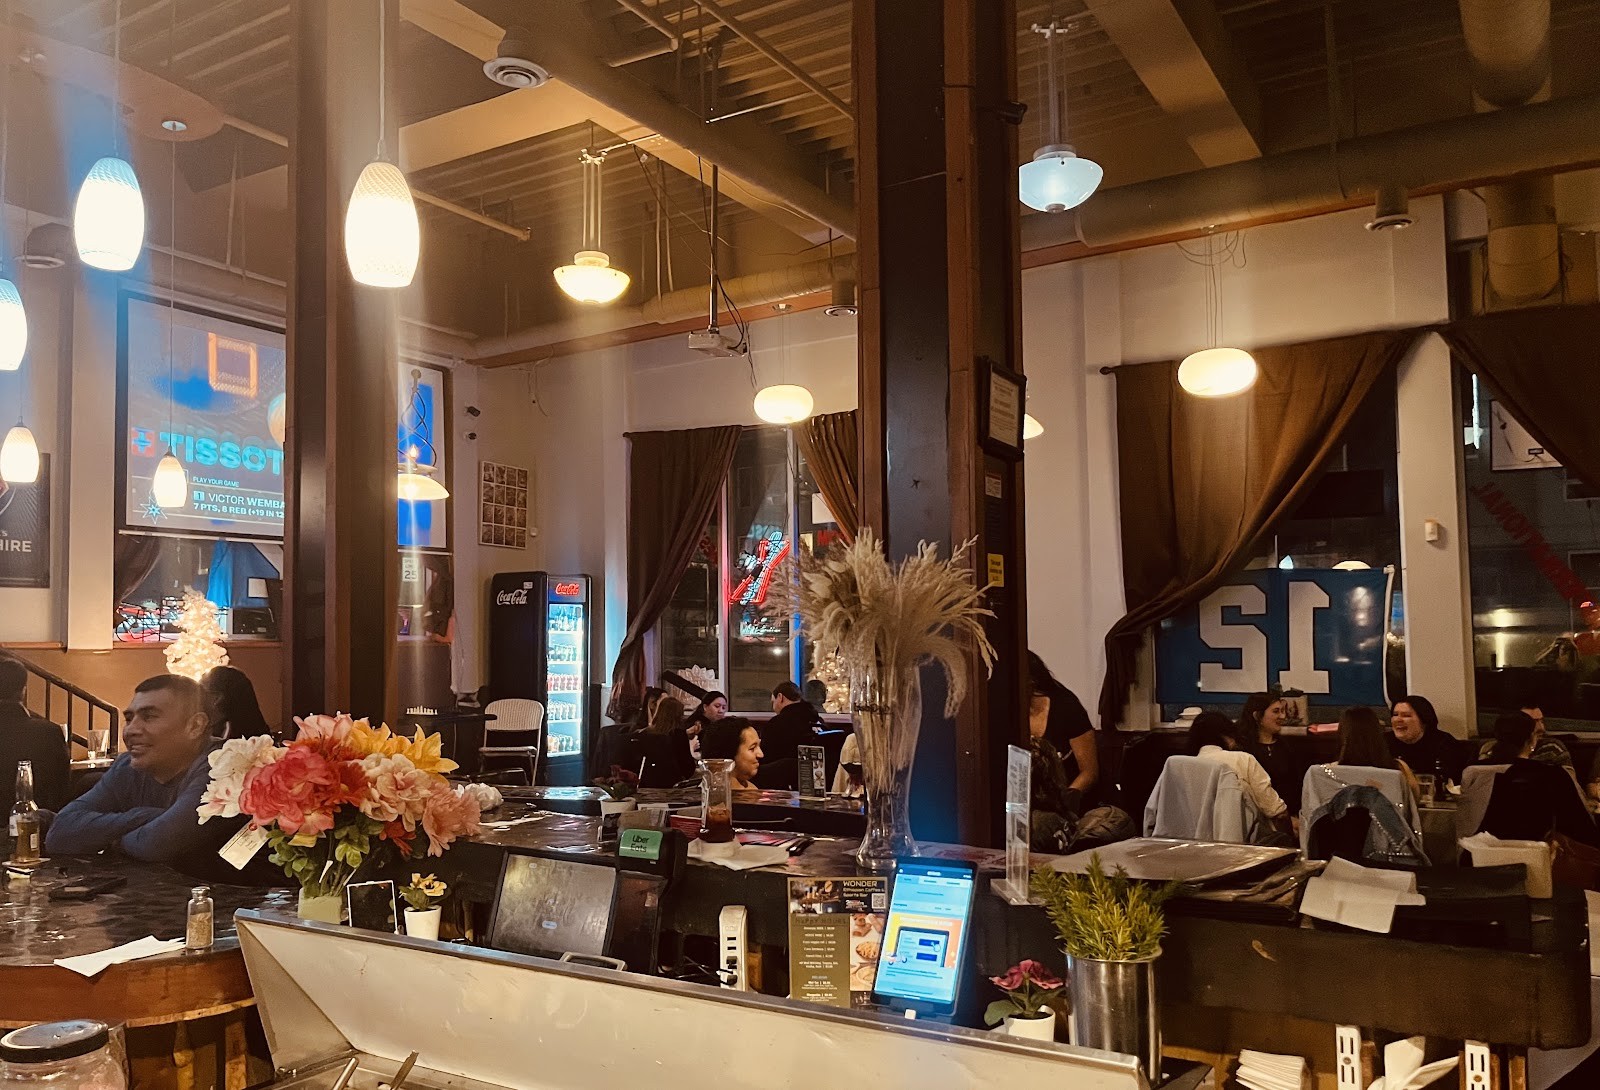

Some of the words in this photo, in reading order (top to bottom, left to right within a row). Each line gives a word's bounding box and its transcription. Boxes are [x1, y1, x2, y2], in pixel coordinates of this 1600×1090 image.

[160, 432, 283, 475] TISSOT
[223, 480, 240, 488] GAME
[208, 492, 244, 505] VICTOR
[200, 504, 221, 513] PTS,
[265, 510, 275, 518] IN
[404, 570, 418, 580] 25
[632, 834, 650, 844] Uber
[630, 843, 647, 853] Eats
[843, 880, 878, 888] WONDER
